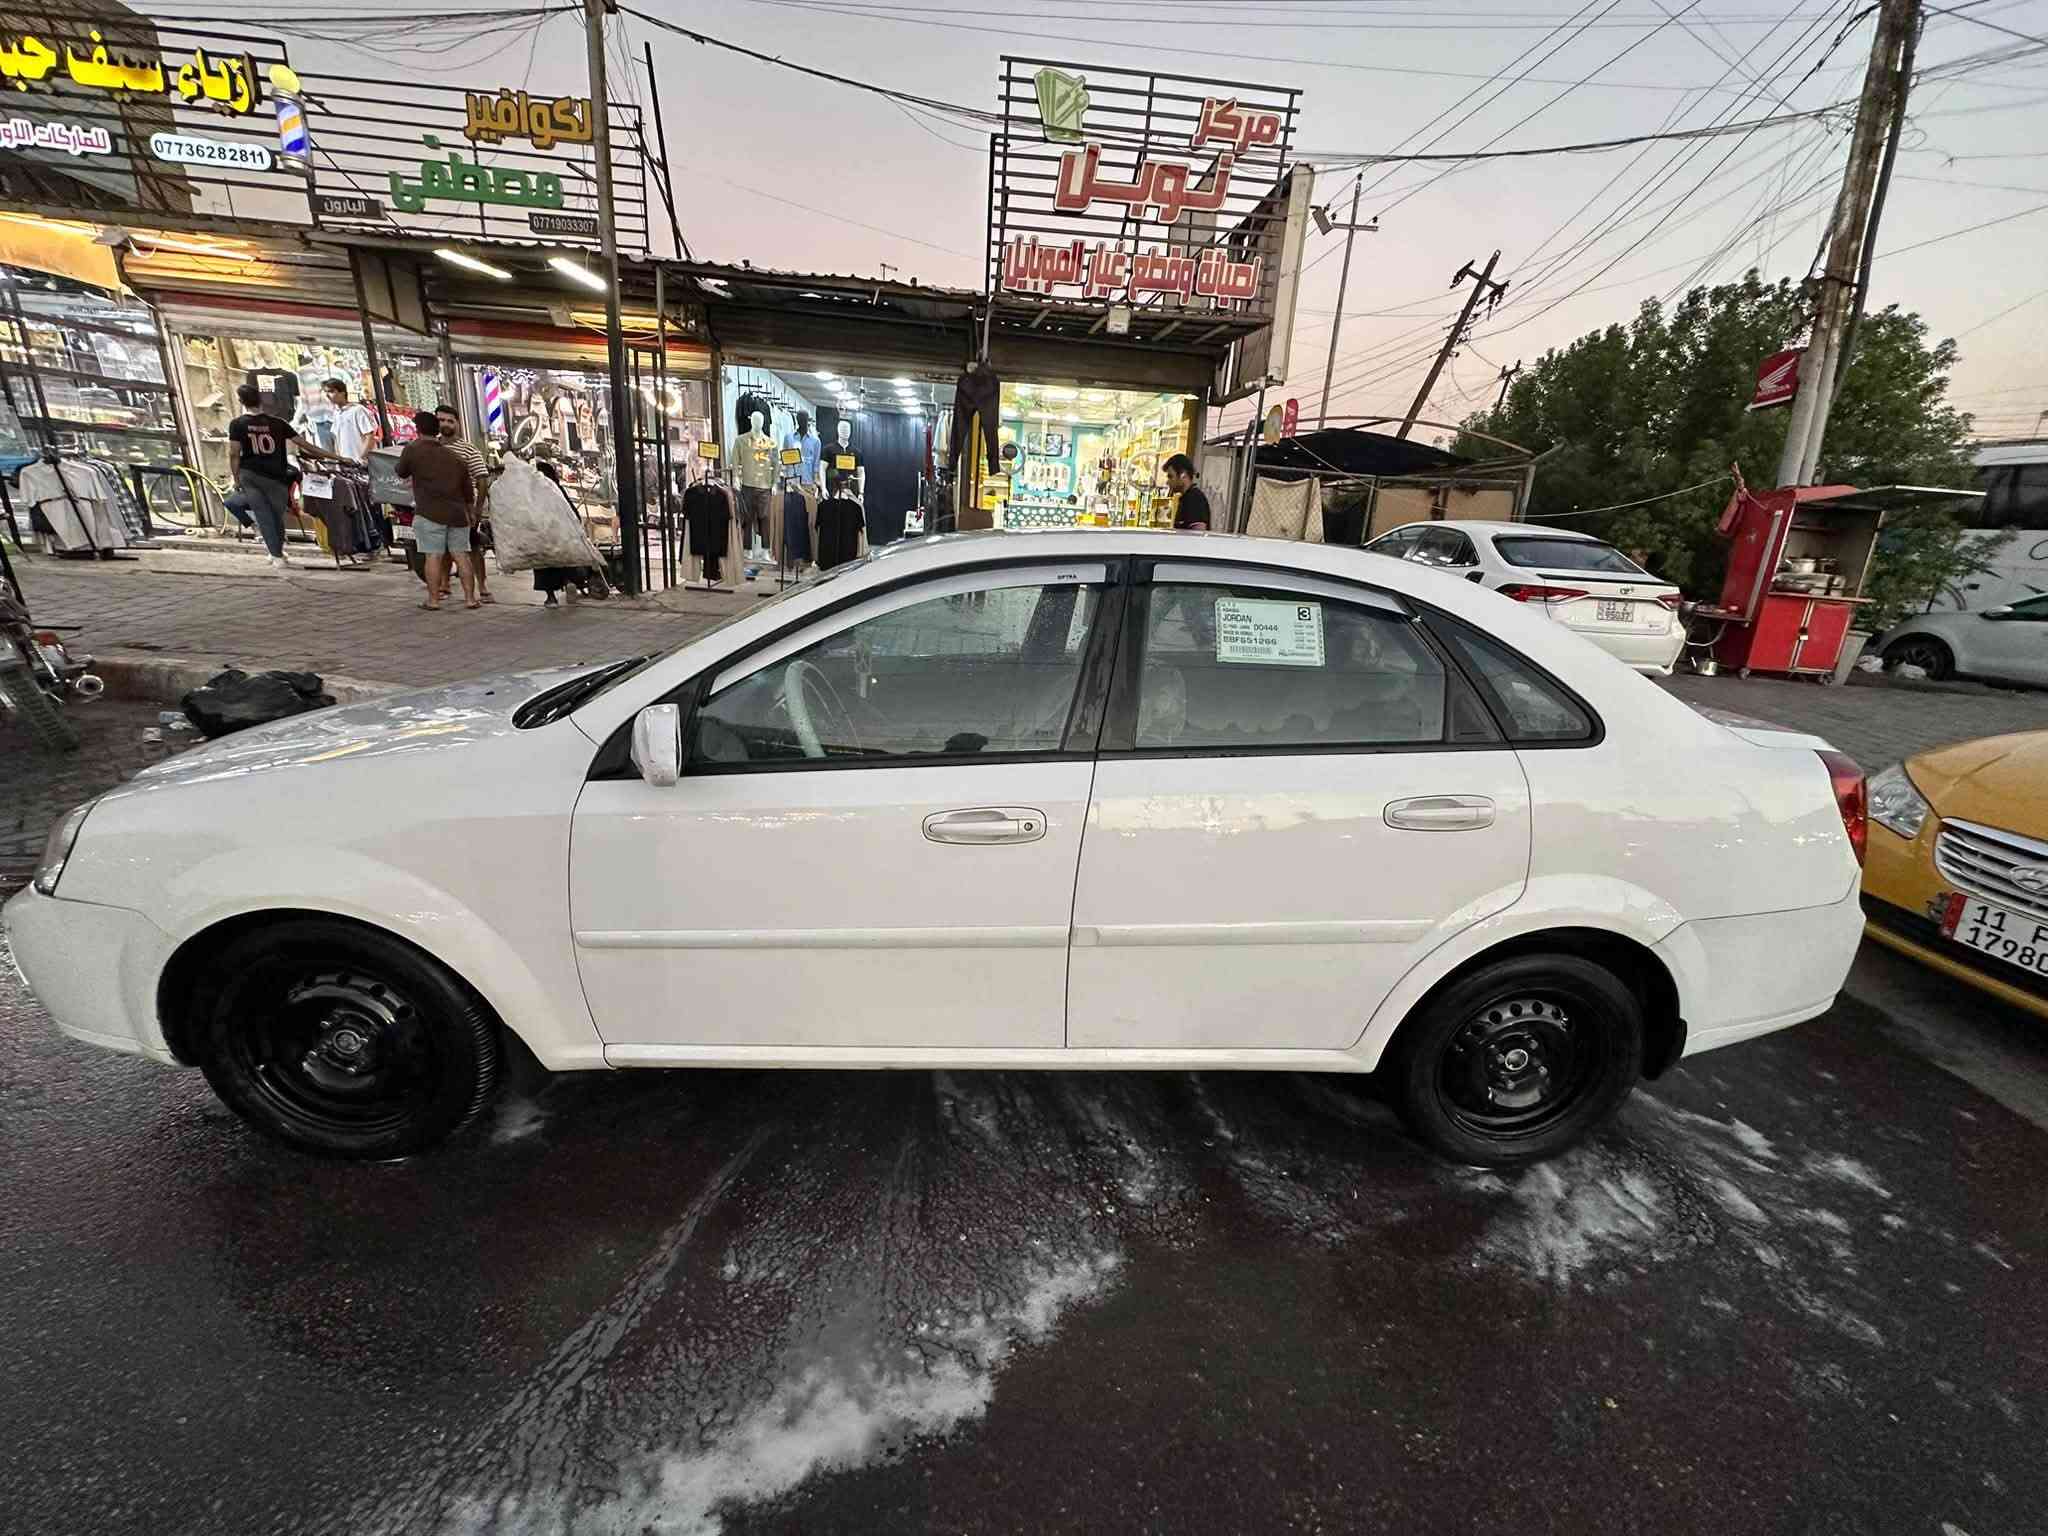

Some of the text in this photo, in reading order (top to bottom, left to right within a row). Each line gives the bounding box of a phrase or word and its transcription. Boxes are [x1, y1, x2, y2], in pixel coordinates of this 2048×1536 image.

[67, 30, 164, 103] سيف
[0, 118, 111, 155] للماركات الاو
[464, 88, 594, 149] لكوافير
[1191, 97, 1281, 154] مركز
[154, 138, 266, 164] 07736282811
[1054, 143, 1235, 224] نوبل
[1083, 240, 1127, 297] غيار
[1196, 248, 1261, 308] صيانة
[247, 432, 275, 455] 10
[1222, 613, 1252, 624] JORDAN
[1299, 608, 1310, 619] 3
[1973, 905, 2007, 932] 11
